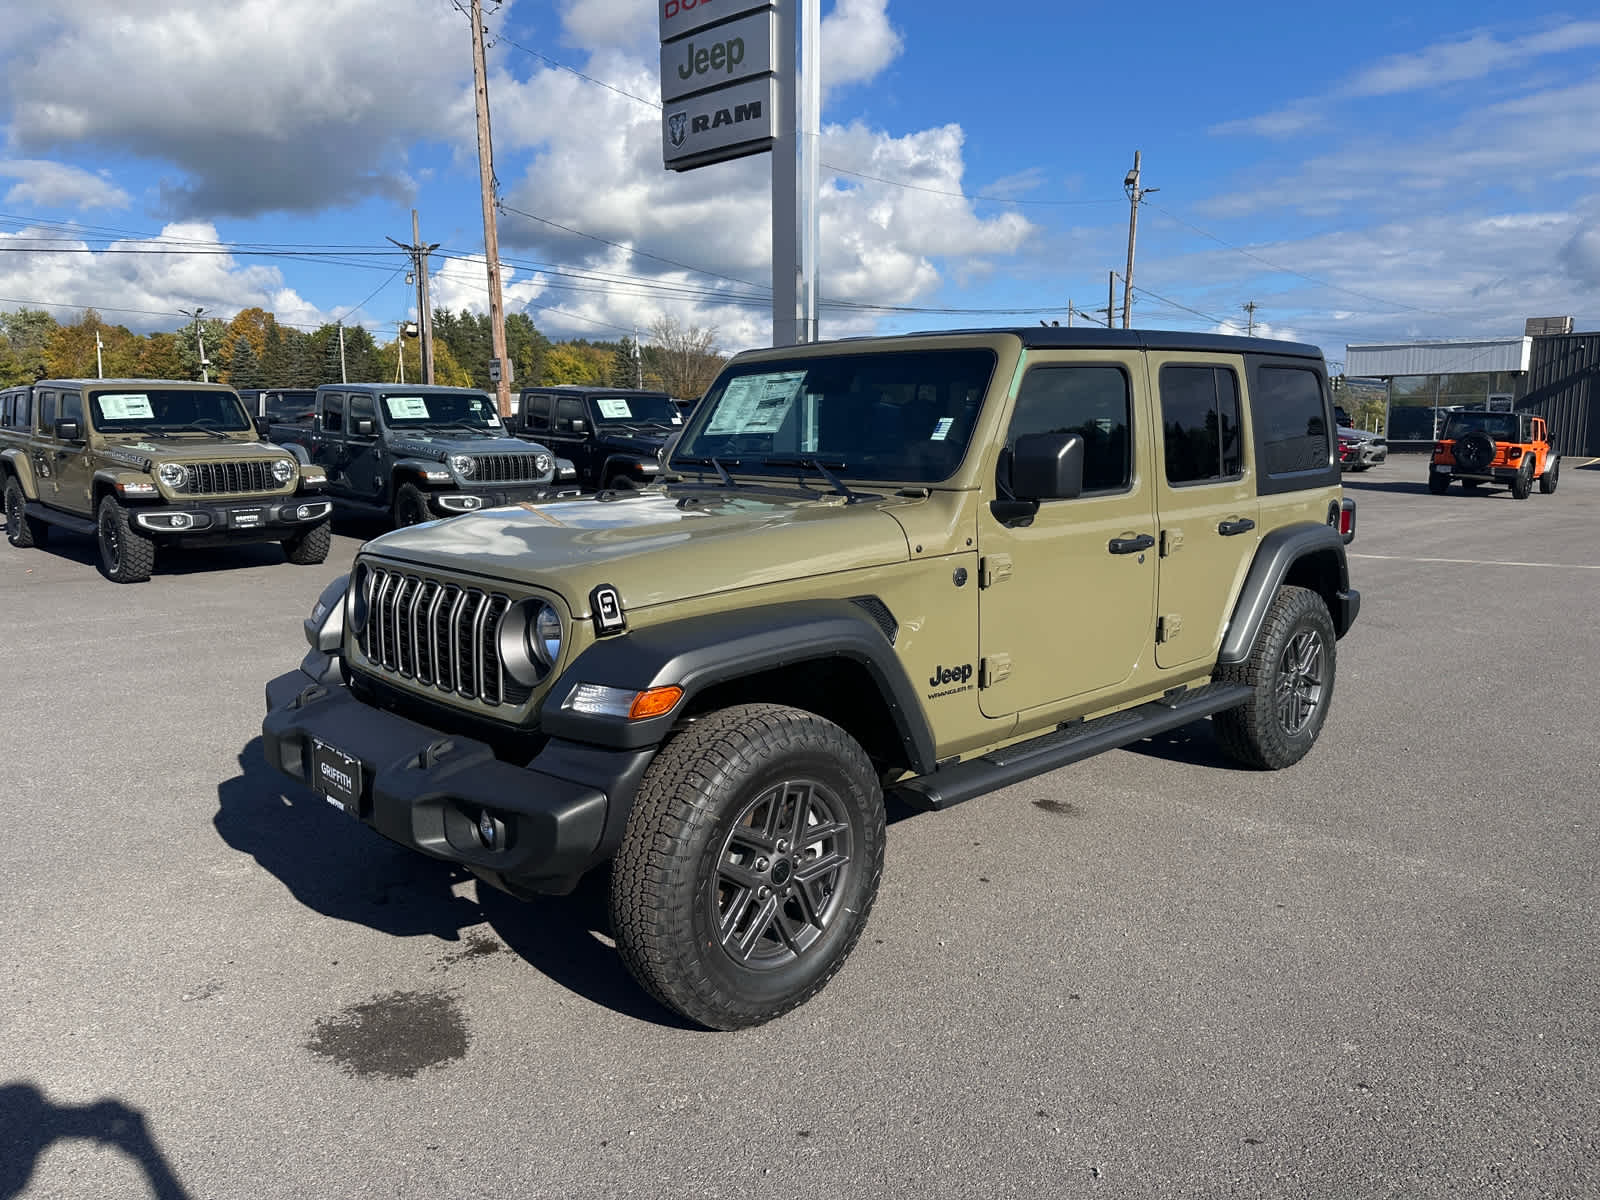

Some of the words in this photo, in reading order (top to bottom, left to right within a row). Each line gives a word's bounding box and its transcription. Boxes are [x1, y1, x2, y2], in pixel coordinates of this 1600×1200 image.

[678, 36, 745, 80] Jeep
[691, 101, 762, 134] RAM
[929, 663, 973, 687] Jeep
[321, 762, 352, 790] GRIFFITH
